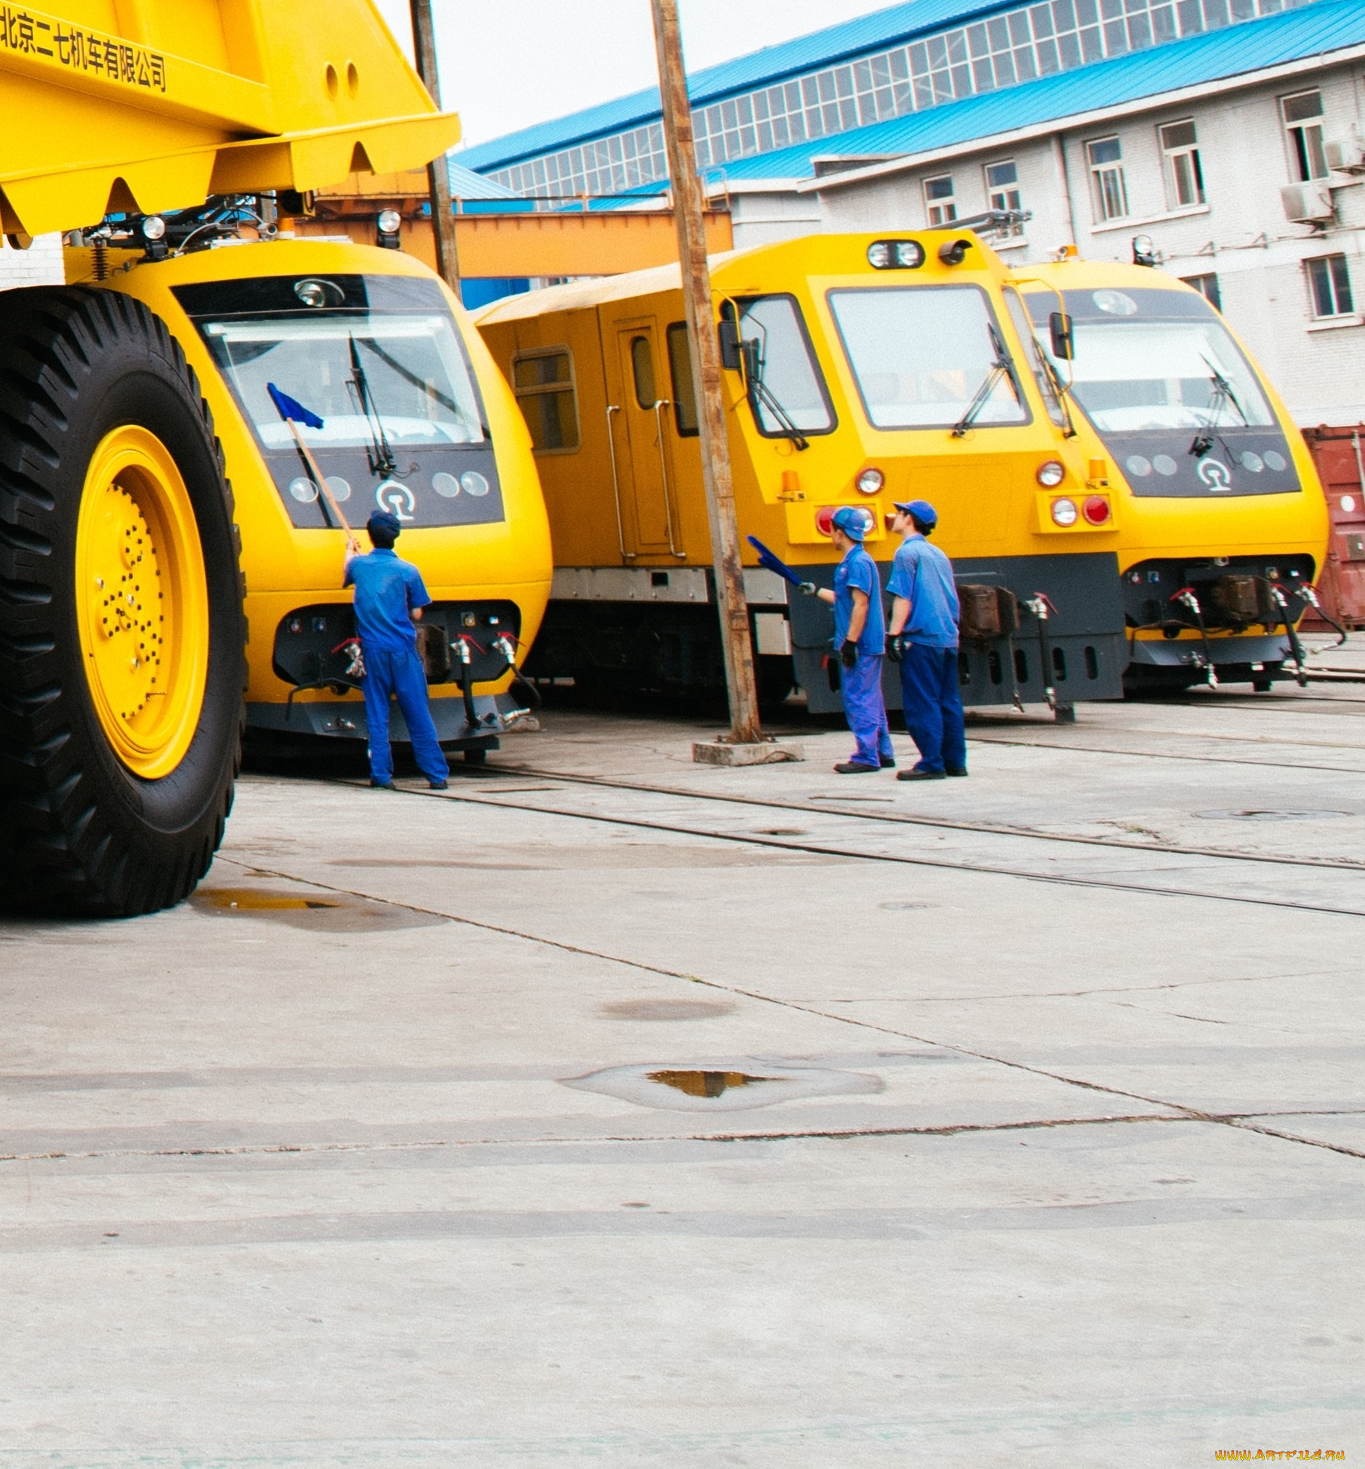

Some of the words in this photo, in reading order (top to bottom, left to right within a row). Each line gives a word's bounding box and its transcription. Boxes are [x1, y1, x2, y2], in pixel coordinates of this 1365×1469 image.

[0, 6, 166, 93] 北京二七机车有限公司
